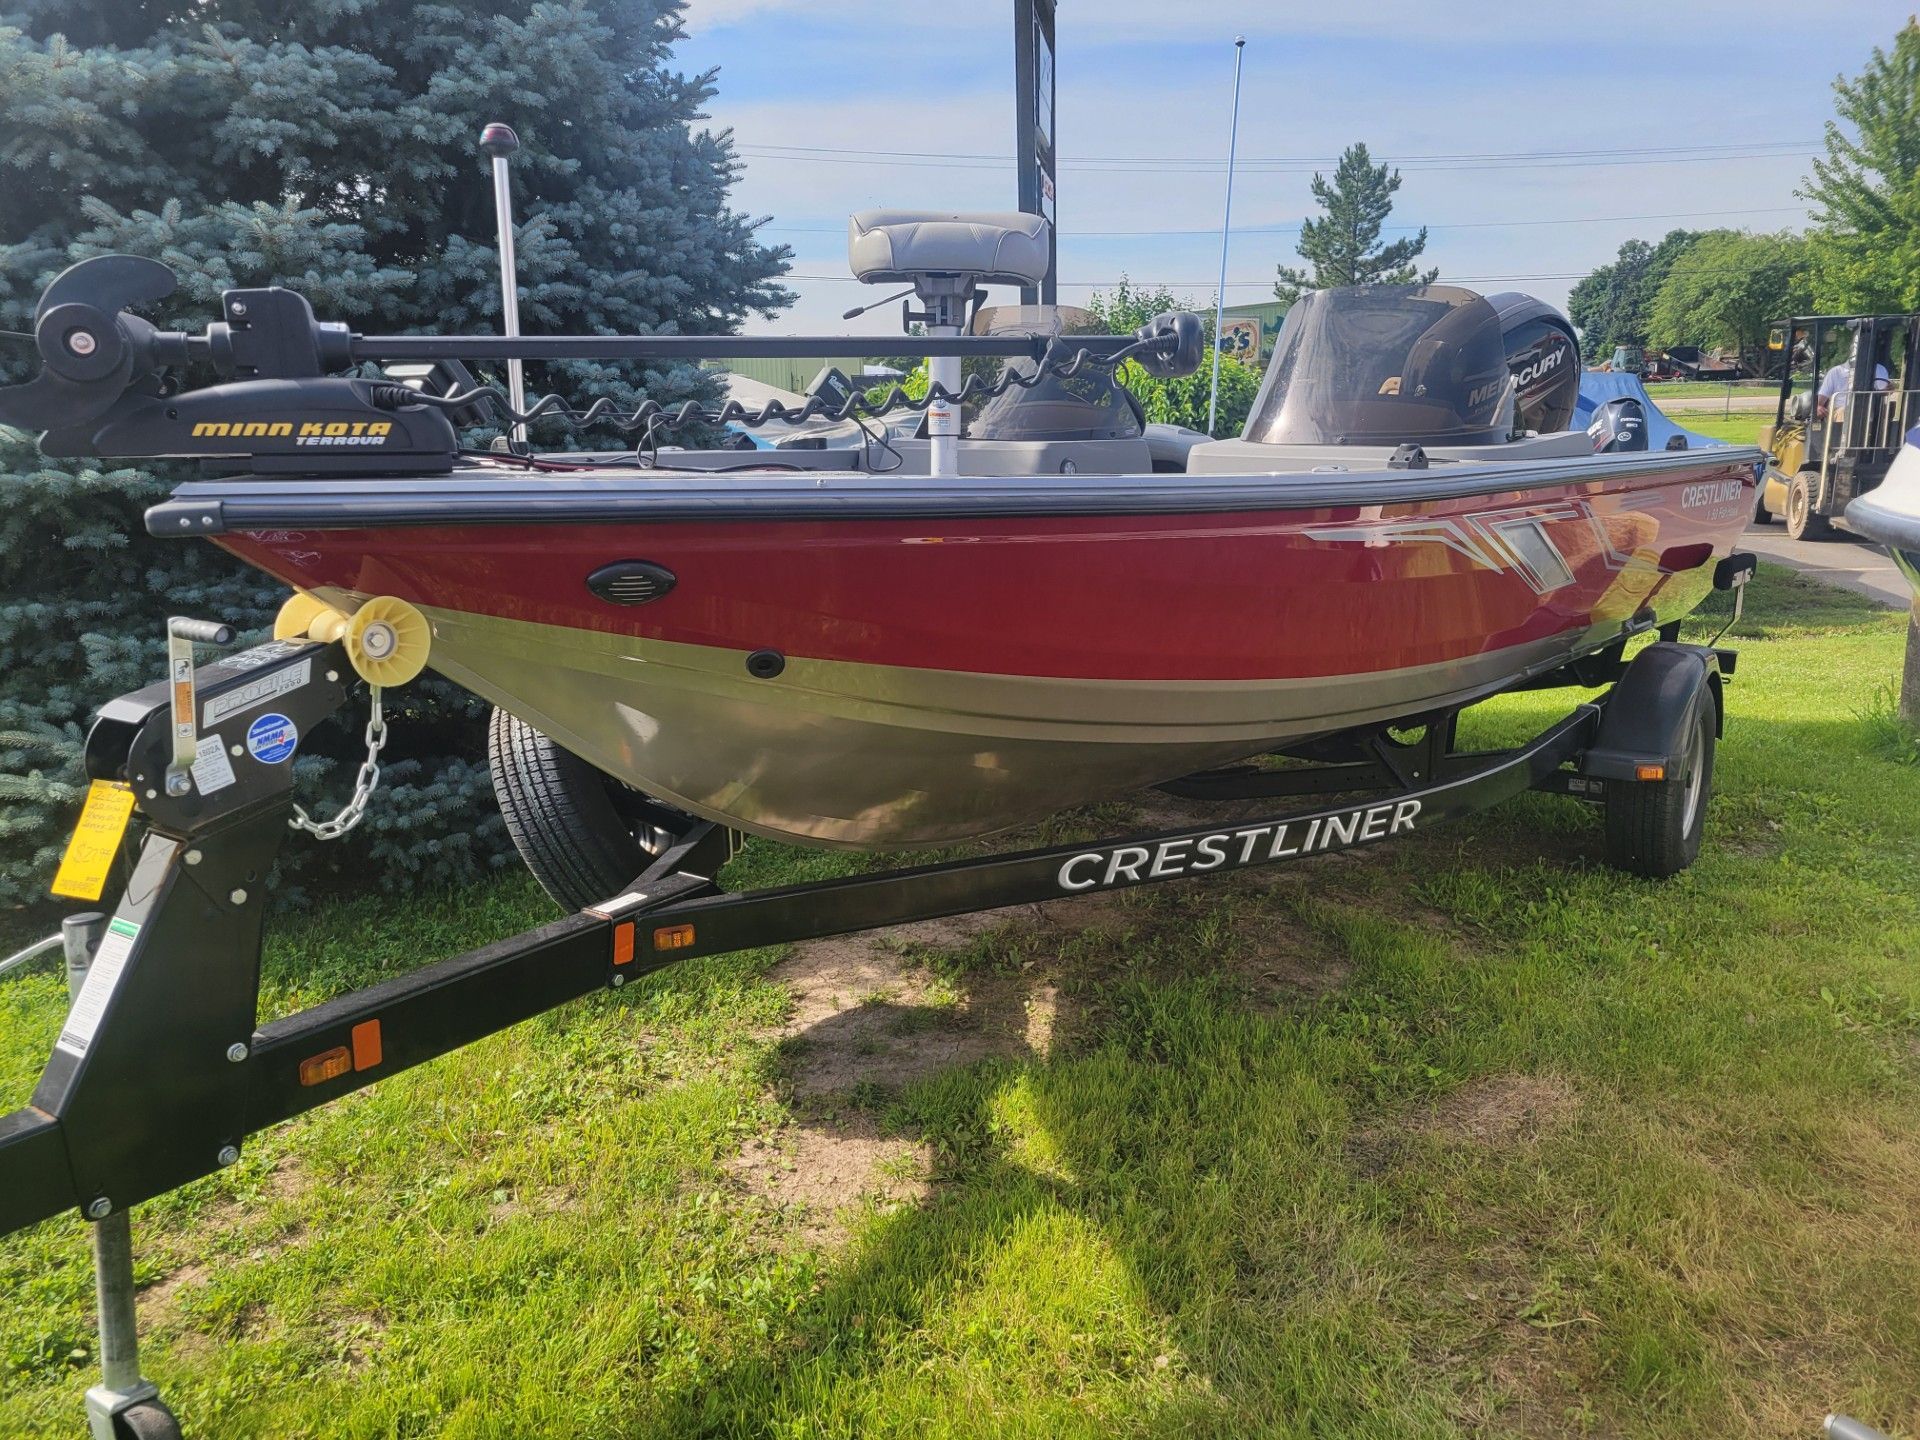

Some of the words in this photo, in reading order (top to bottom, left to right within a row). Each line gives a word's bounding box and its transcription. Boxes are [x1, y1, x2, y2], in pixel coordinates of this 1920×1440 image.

[191, 422, 294, 437] MINN
[300, 422, 393, 437] KOTA
[296, 436, 386, 446] TERROVA
[1681, 480, 1743, 509] CRESTLINER
[1056, 799, 1422, 891] CRESTLINER
